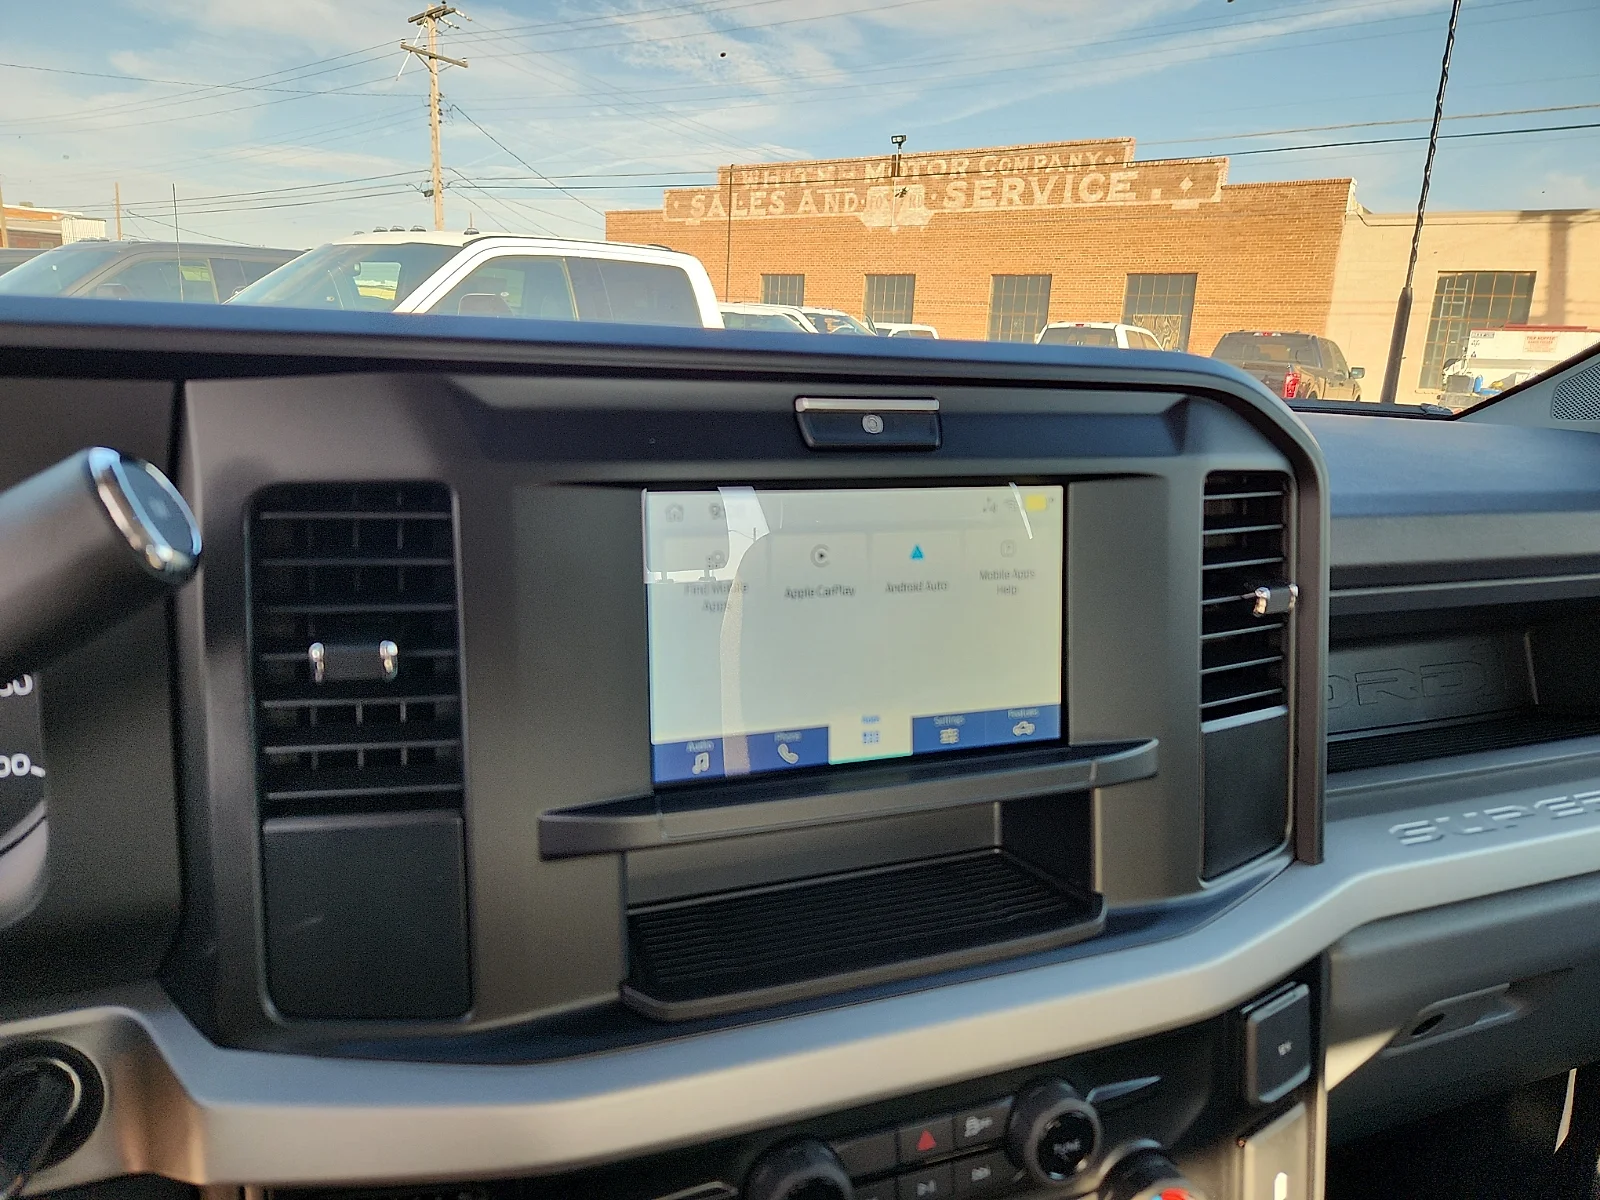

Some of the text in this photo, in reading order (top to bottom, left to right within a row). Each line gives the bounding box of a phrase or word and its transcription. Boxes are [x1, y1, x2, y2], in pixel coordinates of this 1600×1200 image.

[690, 190, 786, 219] SALES
[797, 188, 858, 214] AND
[942, 171, 1140, 209] SERVICE
